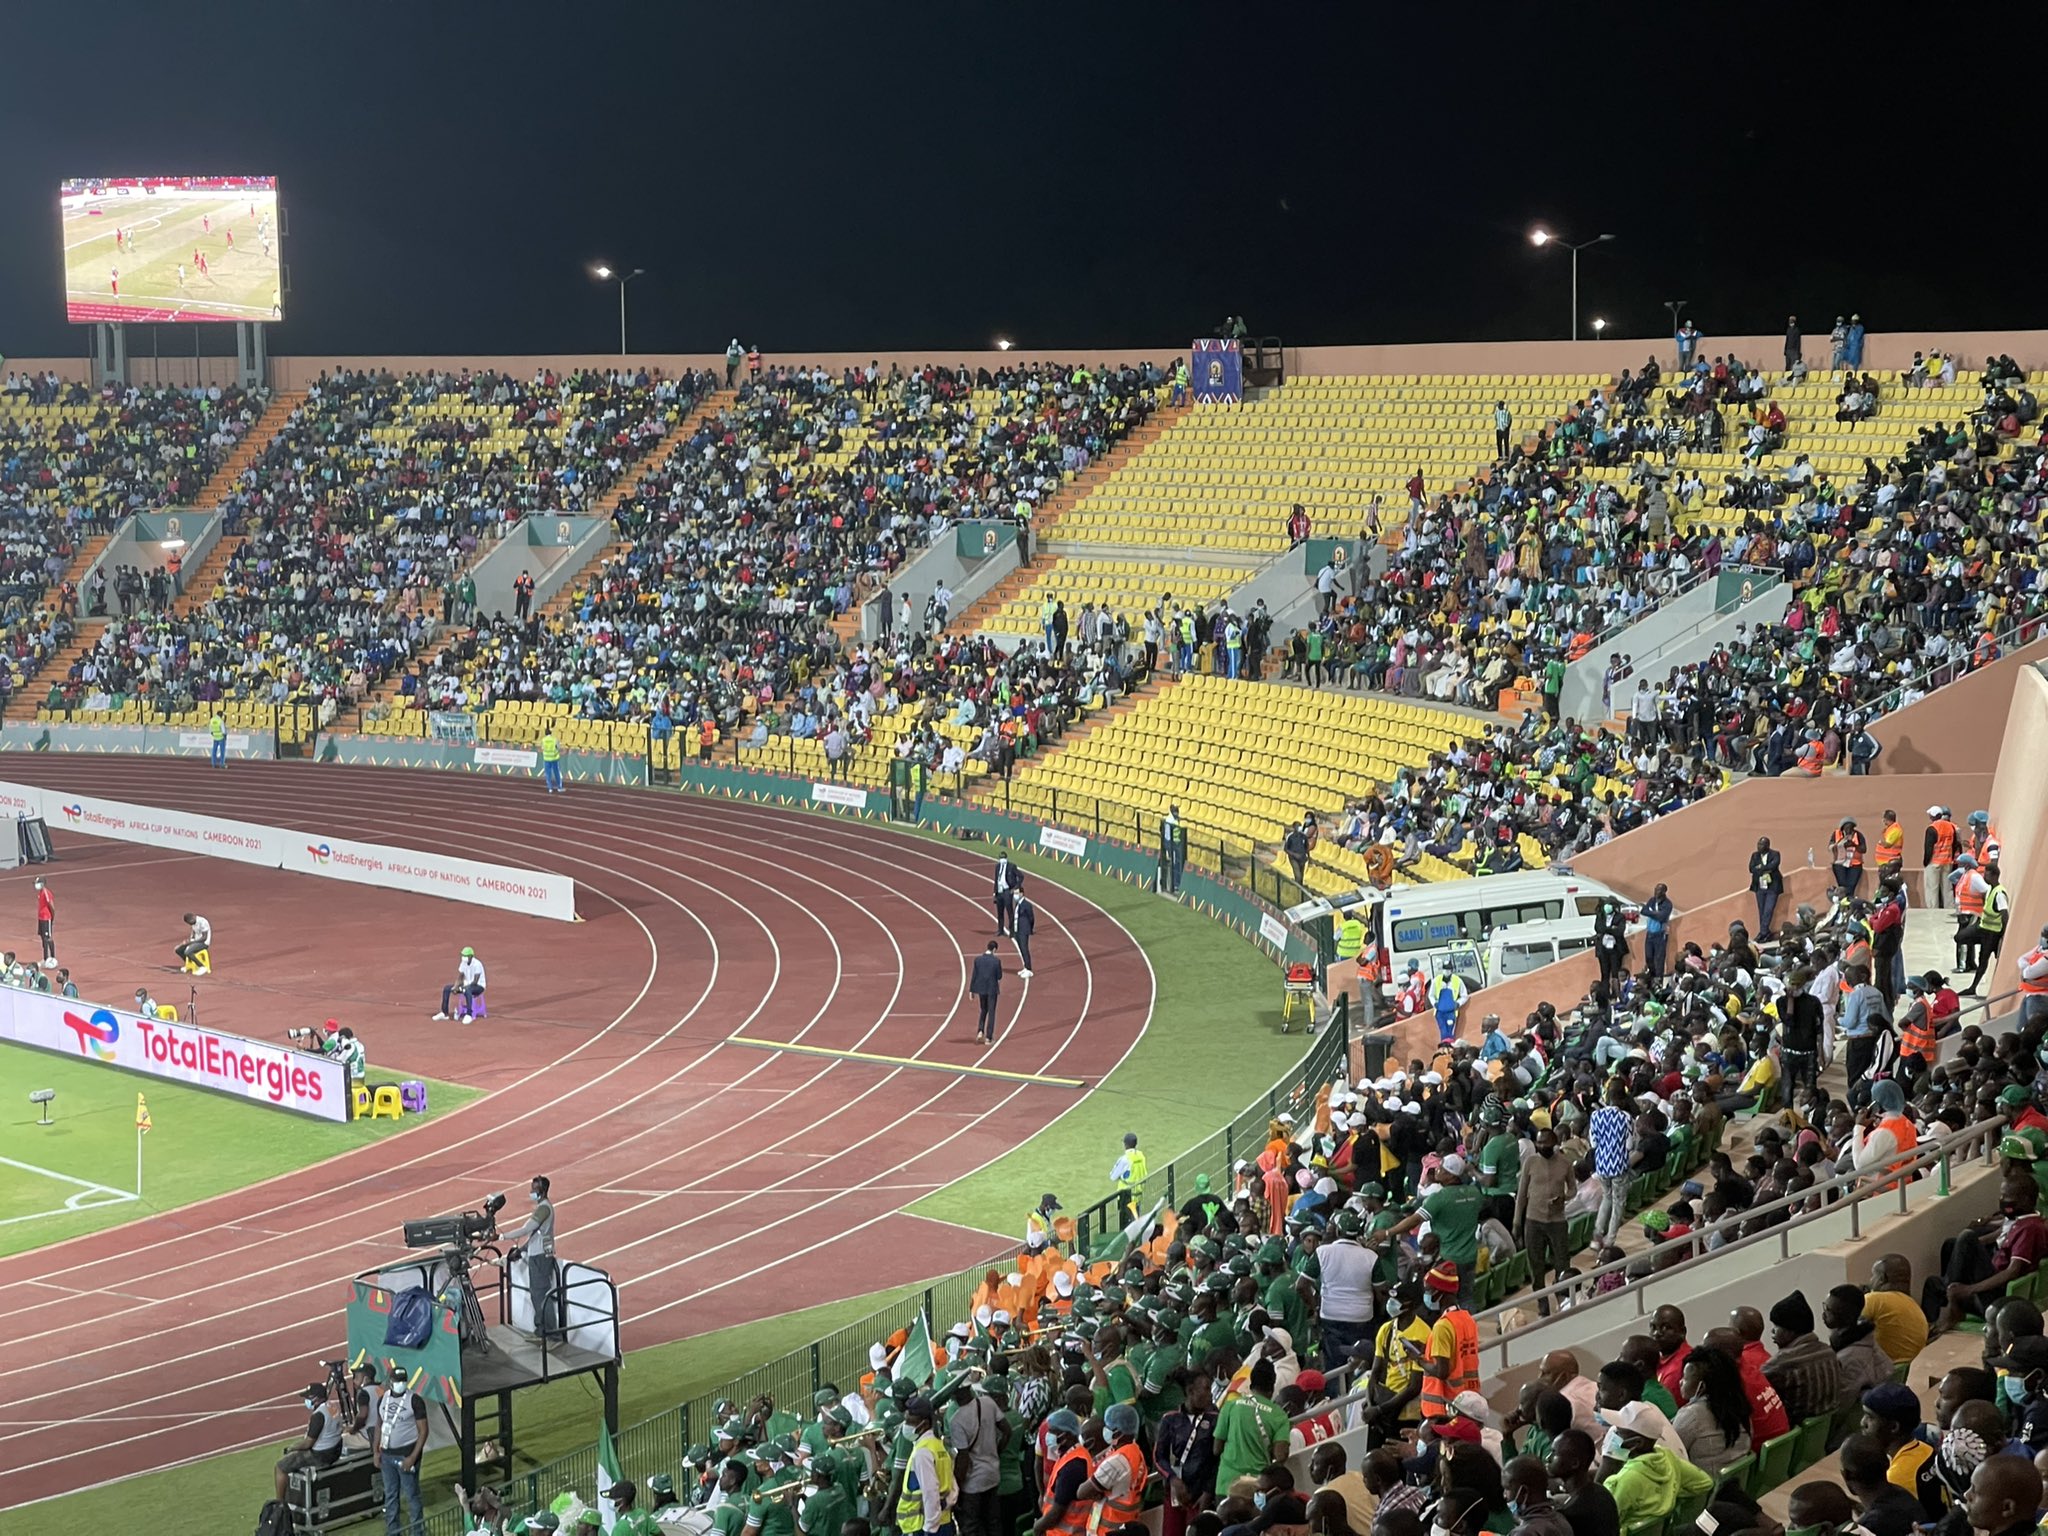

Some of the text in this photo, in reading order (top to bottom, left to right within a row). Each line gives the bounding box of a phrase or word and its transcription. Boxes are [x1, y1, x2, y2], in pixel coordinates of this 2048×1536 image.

[83, 811, 125, 829] TotalEnergies
[129, 821, 149, 832] AFRICA
[151, 824, 162, 833] CUP
[163, 827, 172, 835] OF
[173, 828, 198, 839] NATIONS
[203, 831, 243, 846] CAMEROON
[245, 838, 262, 849] 2021
[332, 850, 383, 871] TotalEnergies
[388, 863, 412, 875] AFRICA
[414, 867, 428, 877] CUP
[429, 870, 439, 880] OF
[440, 872, 470, 886] NATIONS
[476, 877, 525, 896] CAMEROON
[528, 886, 547, 899] 2021
[1398, 928, 1424, 942] SAMU
[137, 1021, 322, 1101] TotalEnergies
